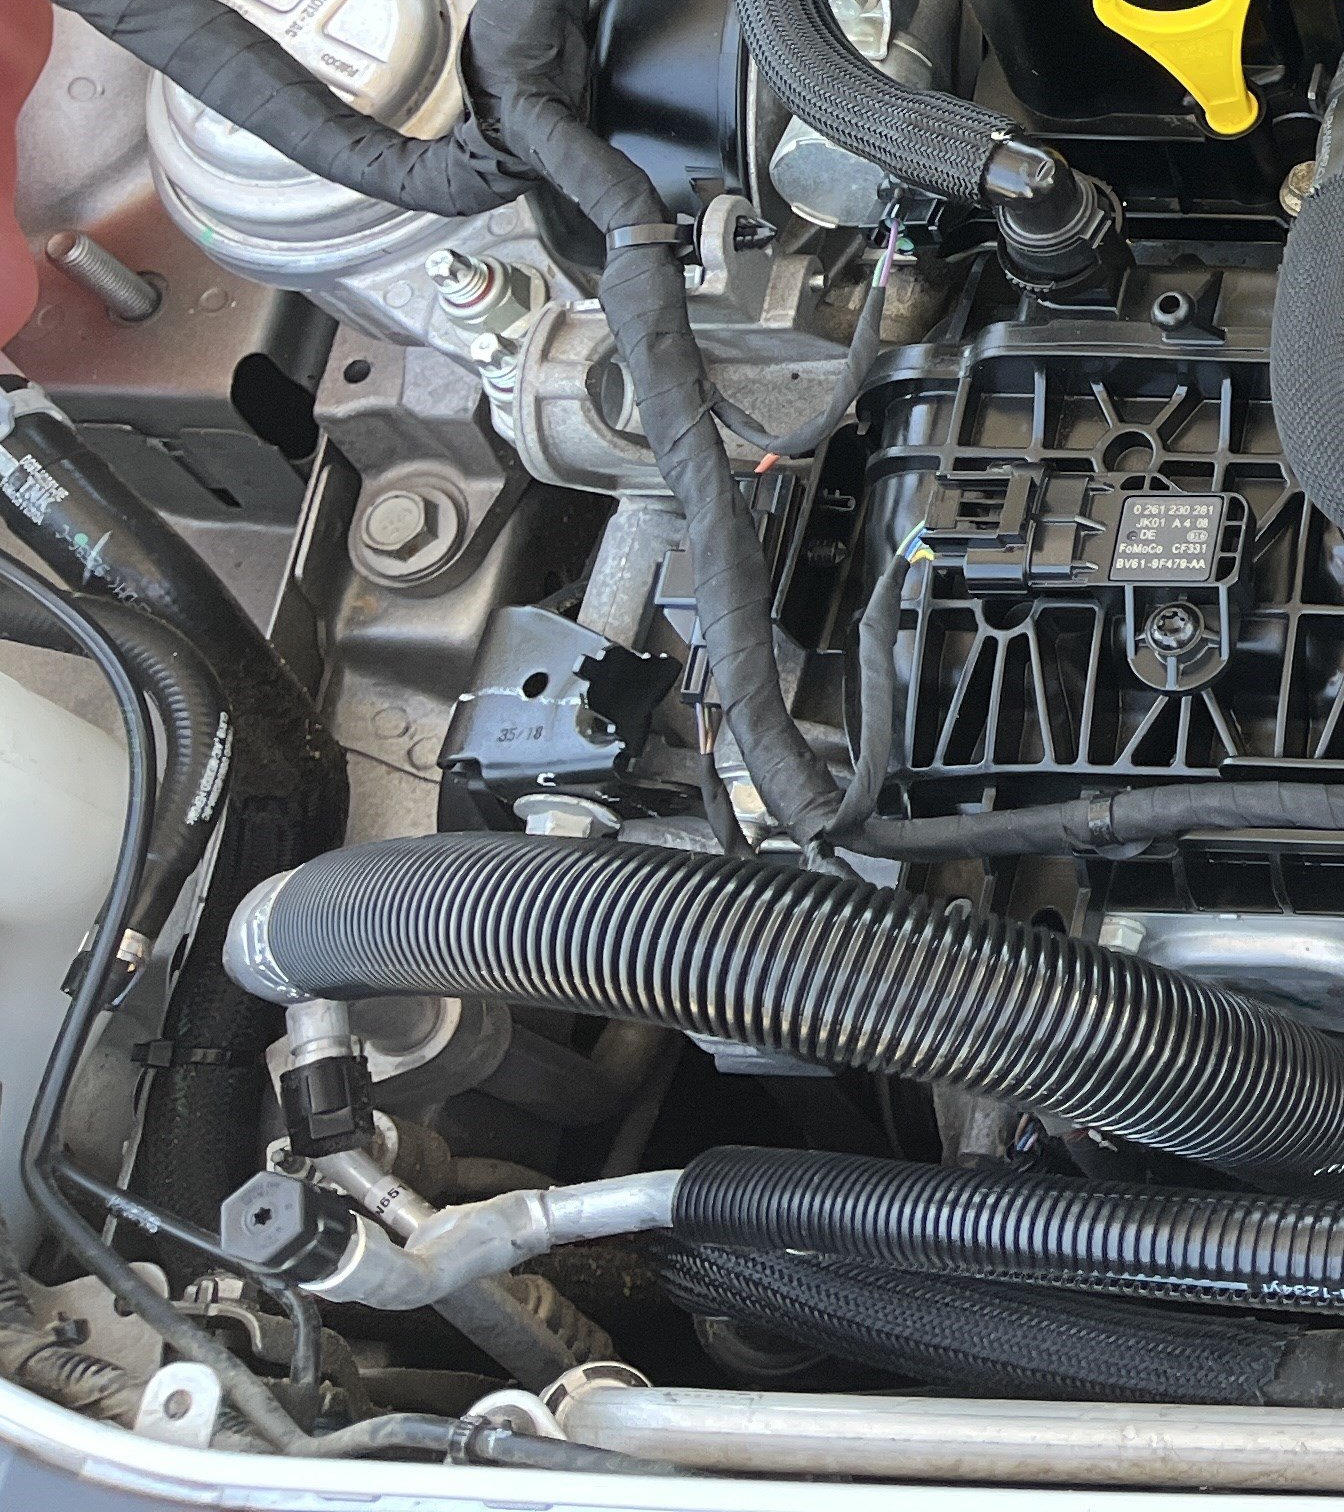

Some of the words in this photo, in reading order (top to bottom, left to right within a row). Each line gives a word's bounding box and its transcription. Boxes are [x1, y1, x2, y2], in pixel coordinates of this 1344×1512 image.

[1133, 504, 1142, 515] 0
[1143, 504, 1165, 515] 261
[1168, 504, 1191, 515] 230
[1193, 504, 1214, 515] 281
[1136, 518, 1166, 528] JK01
[1140, 530, 1156, 540] DE
[1119, 544, 1164, 554] FoMoCo
[1171, 544, 1207, 554] CF331
[1115, 559, 1206, 569] BV61-9F479-AA
